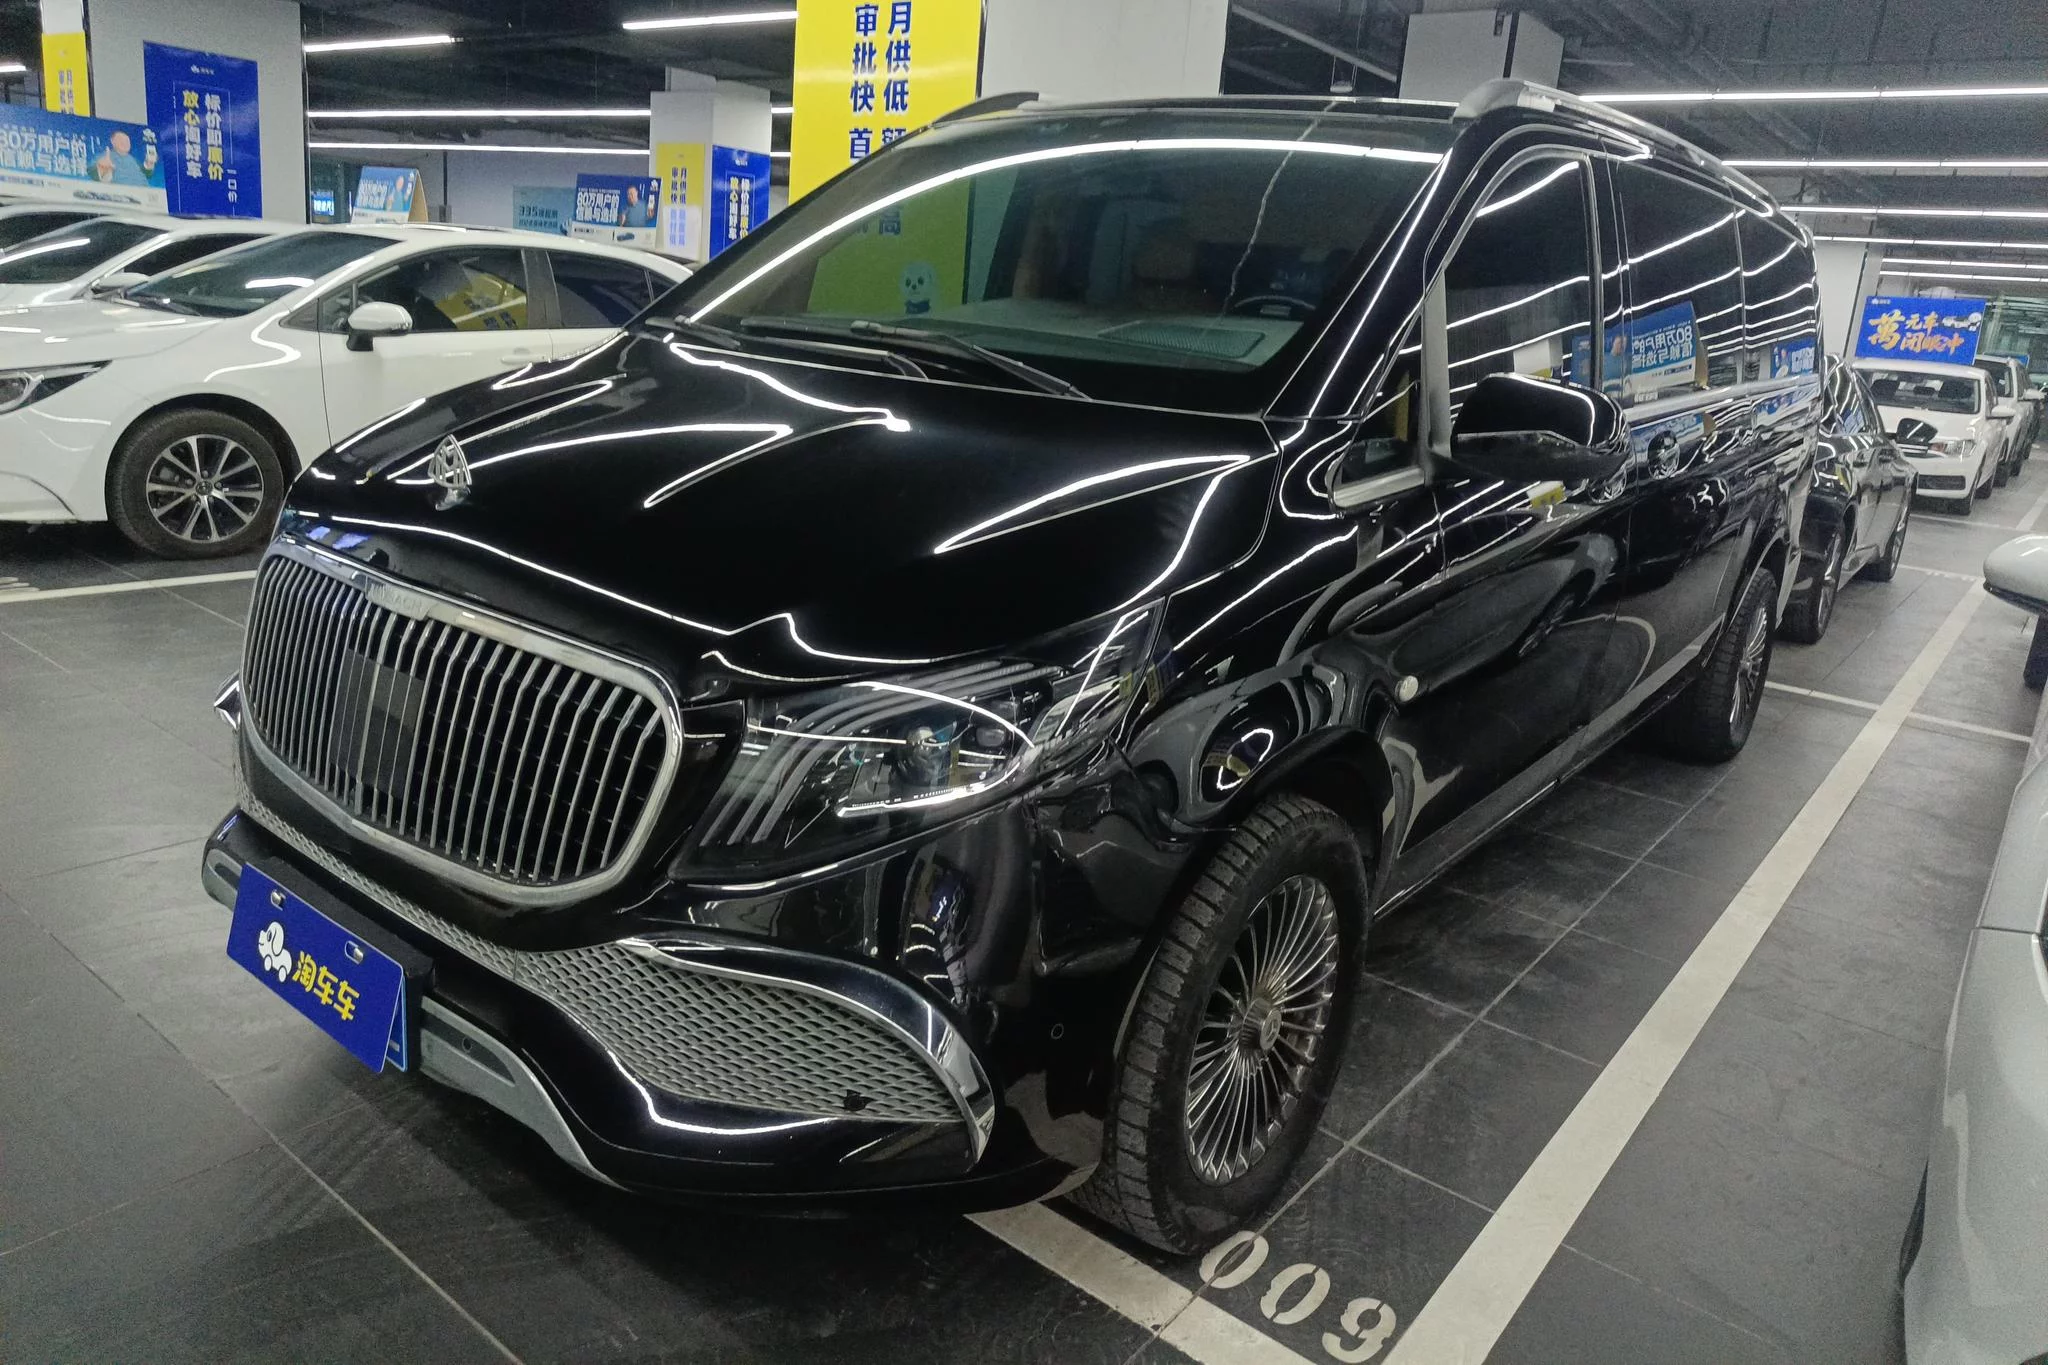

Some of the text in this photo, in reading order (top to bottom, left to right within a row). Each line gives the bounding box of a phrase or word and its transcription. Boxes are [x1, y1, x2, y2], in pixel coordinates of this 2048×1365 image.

[291, 951, 360, 1021] 淘车车
[1198, 1230, 1397, 1364] 009
